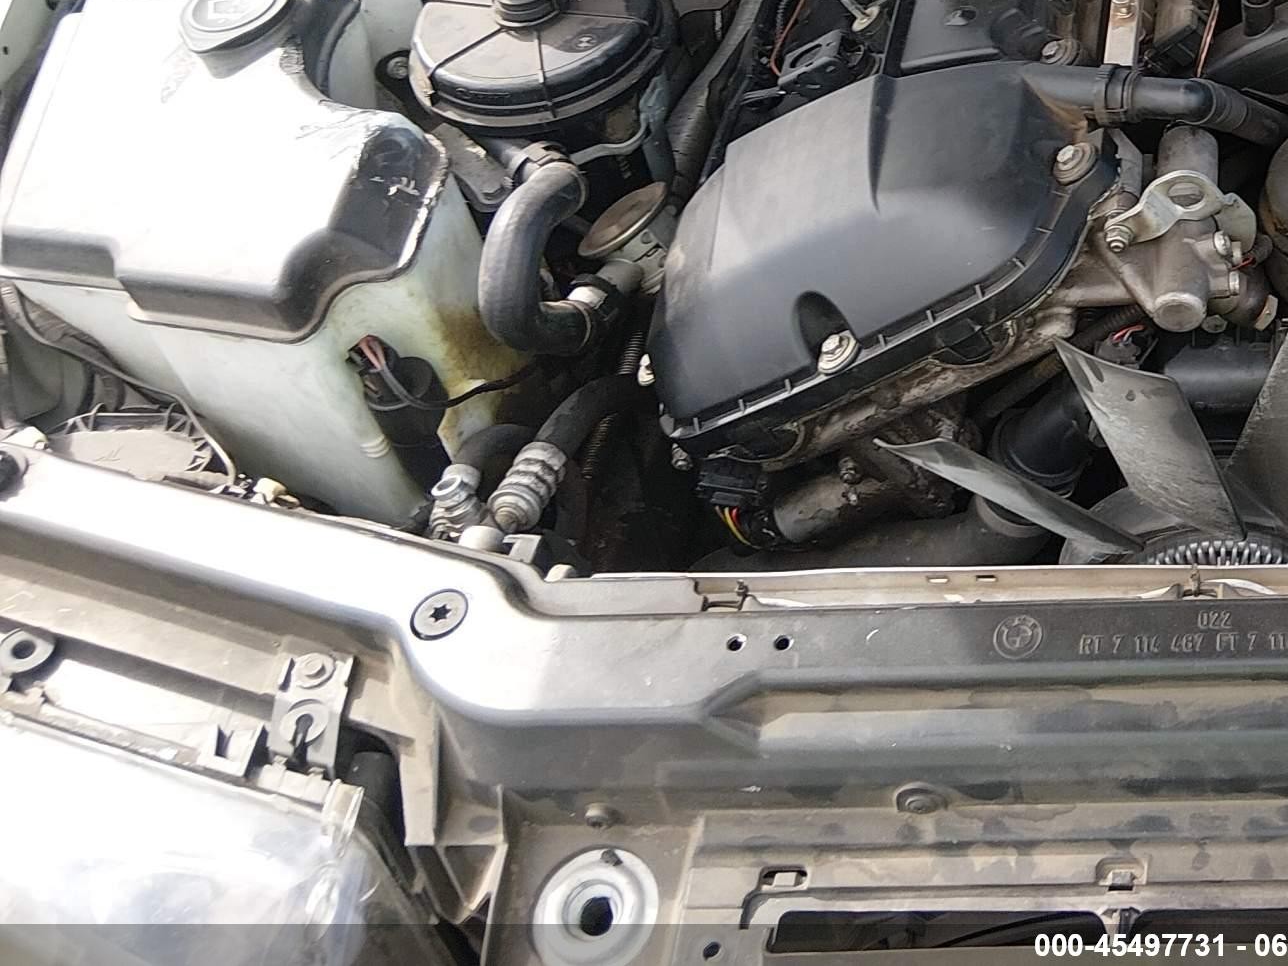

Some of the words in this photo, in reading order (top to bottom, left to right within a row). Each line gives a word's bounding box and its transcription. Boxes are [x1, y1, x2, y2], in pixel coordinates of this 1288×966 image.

[1198, 610, 1232, 629] 022
[1079, 633, 1104, 654] RT
[1112, 634, 1125, 654] 7
[1134, 634, 1161, 653] 114
[1247, 631, 1259, 651] 7
